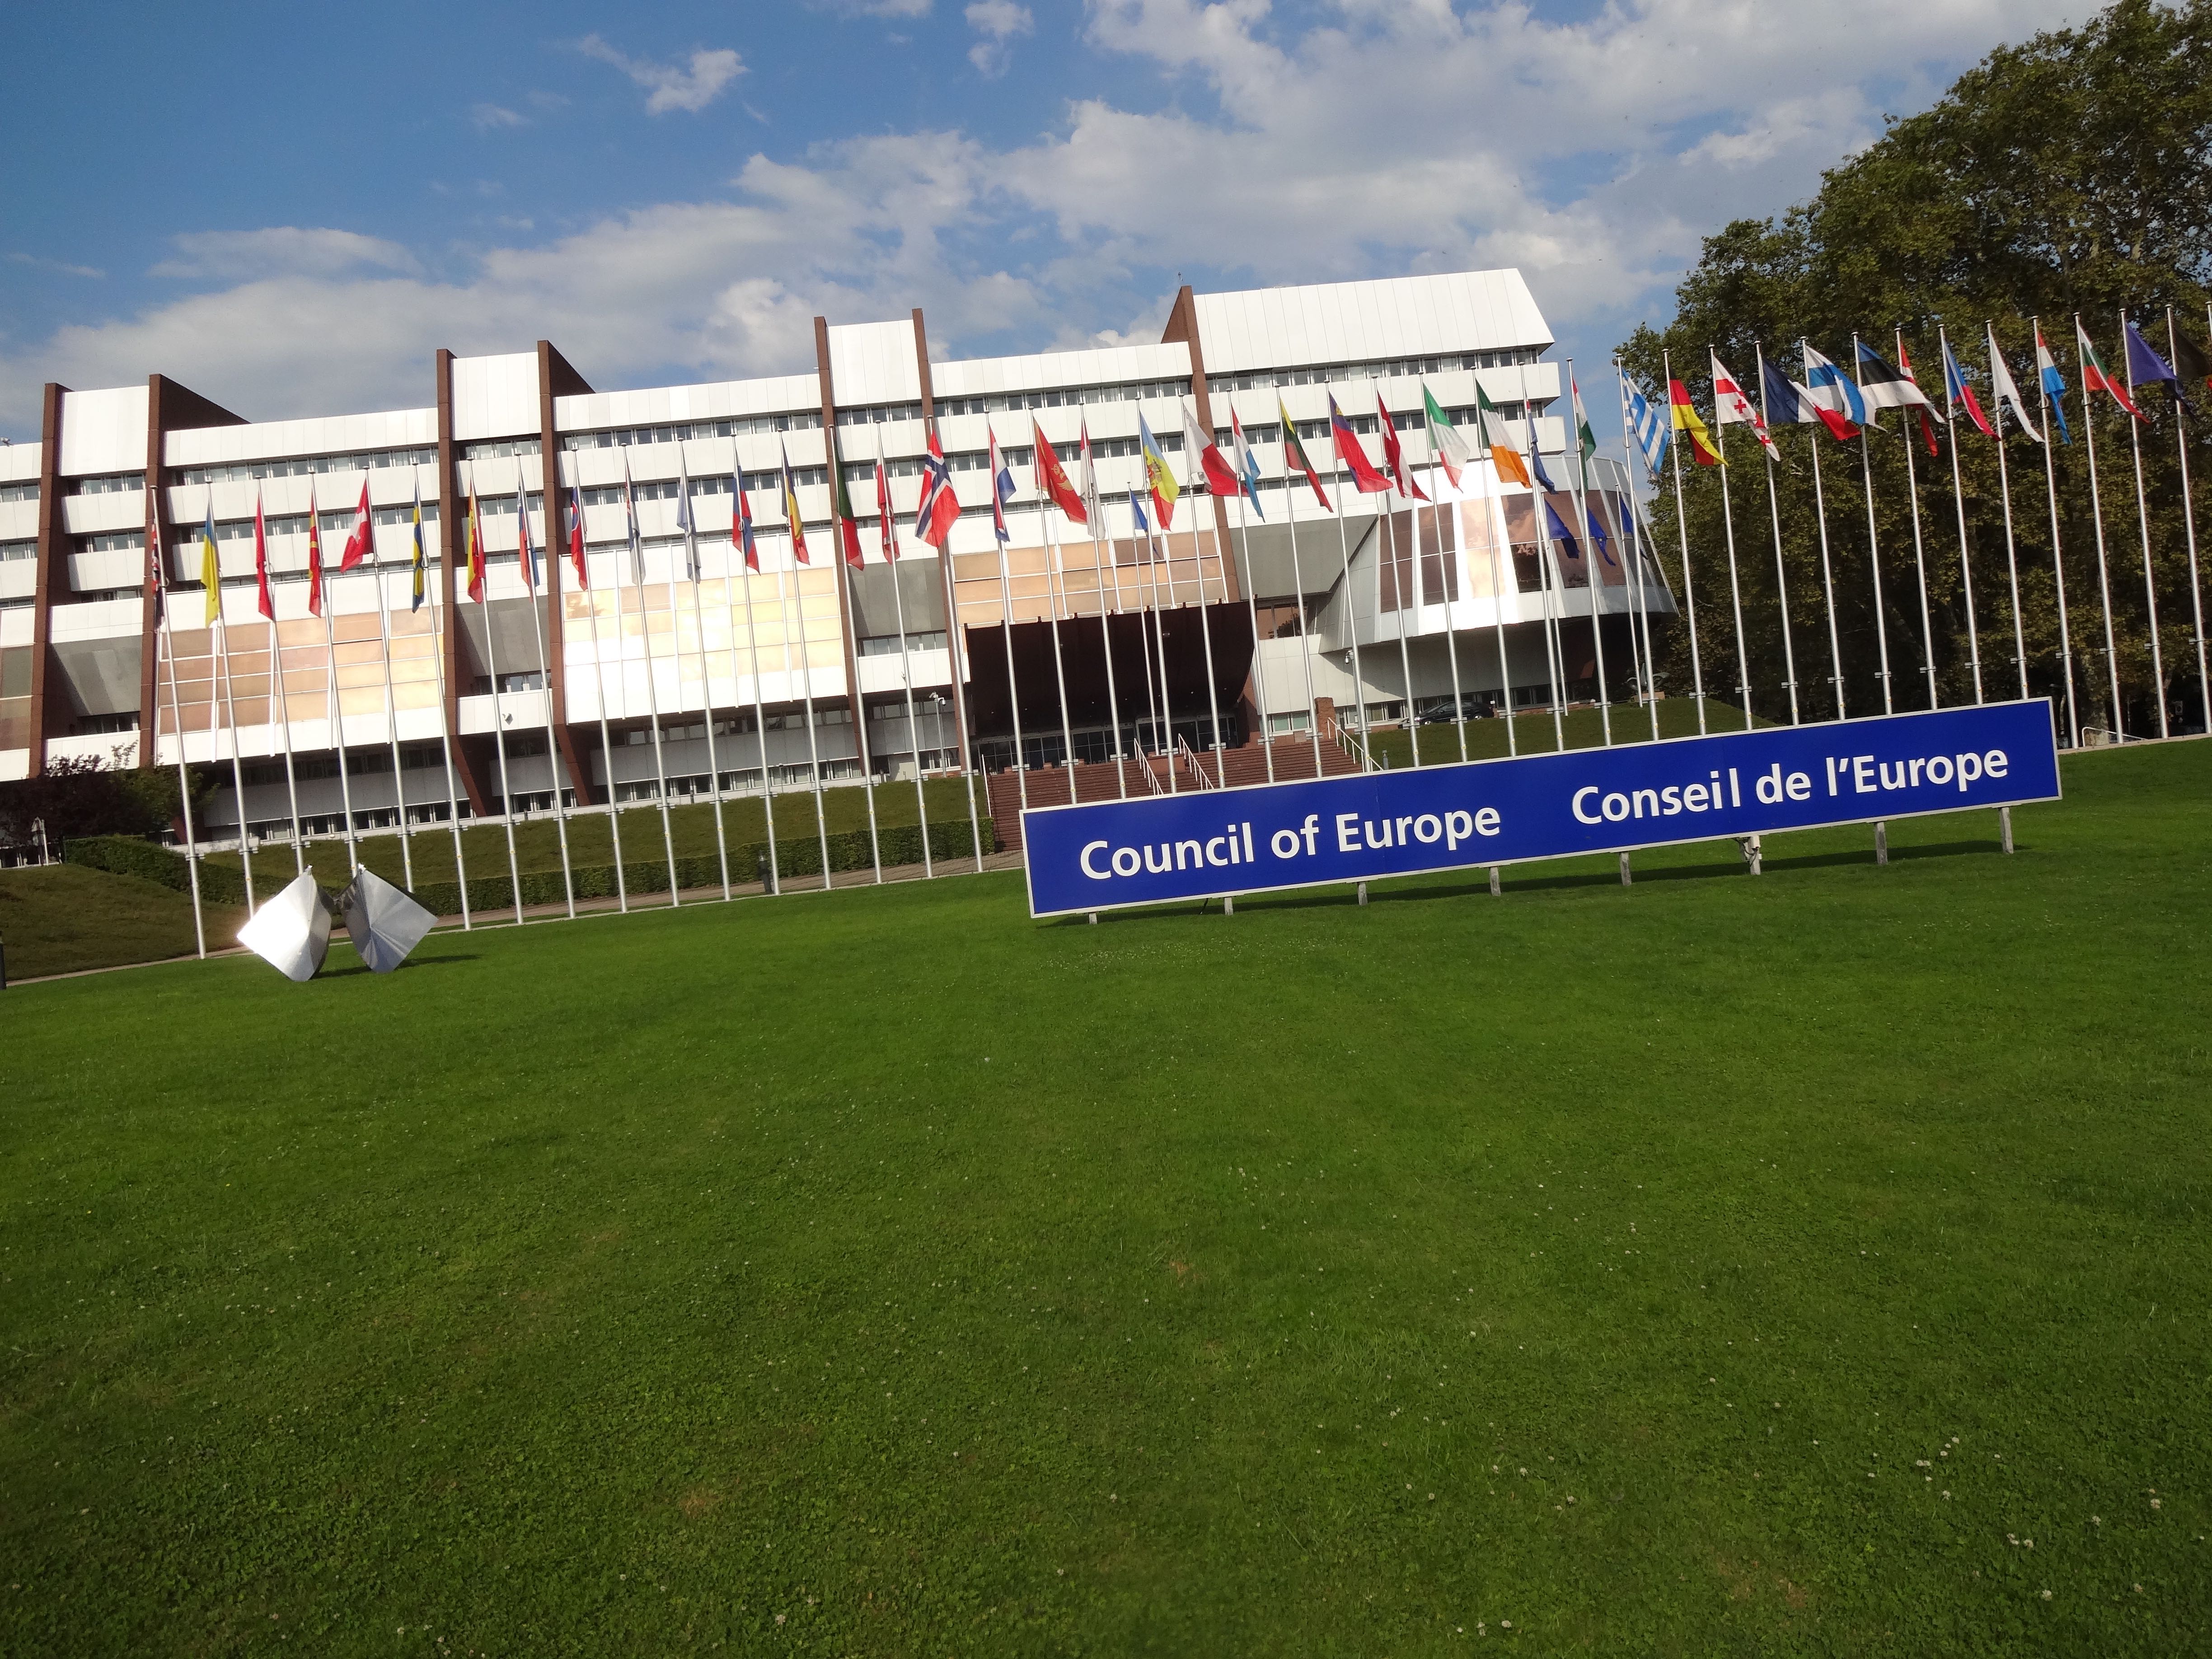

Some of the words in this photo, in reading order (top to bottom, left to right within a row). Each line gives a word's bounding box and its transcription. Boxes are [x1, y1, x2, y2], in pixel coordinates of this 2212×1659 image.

[1572, 768, 1741, 824] Conseil
[1756, 763, 1811, 804] de
[1826, 750, 2008, 797] l'Europe
[1080, 822, 1255, 880] Council
[1271, 814, 1320, 858] of
[1336, 807, 1500, 852] Europe
